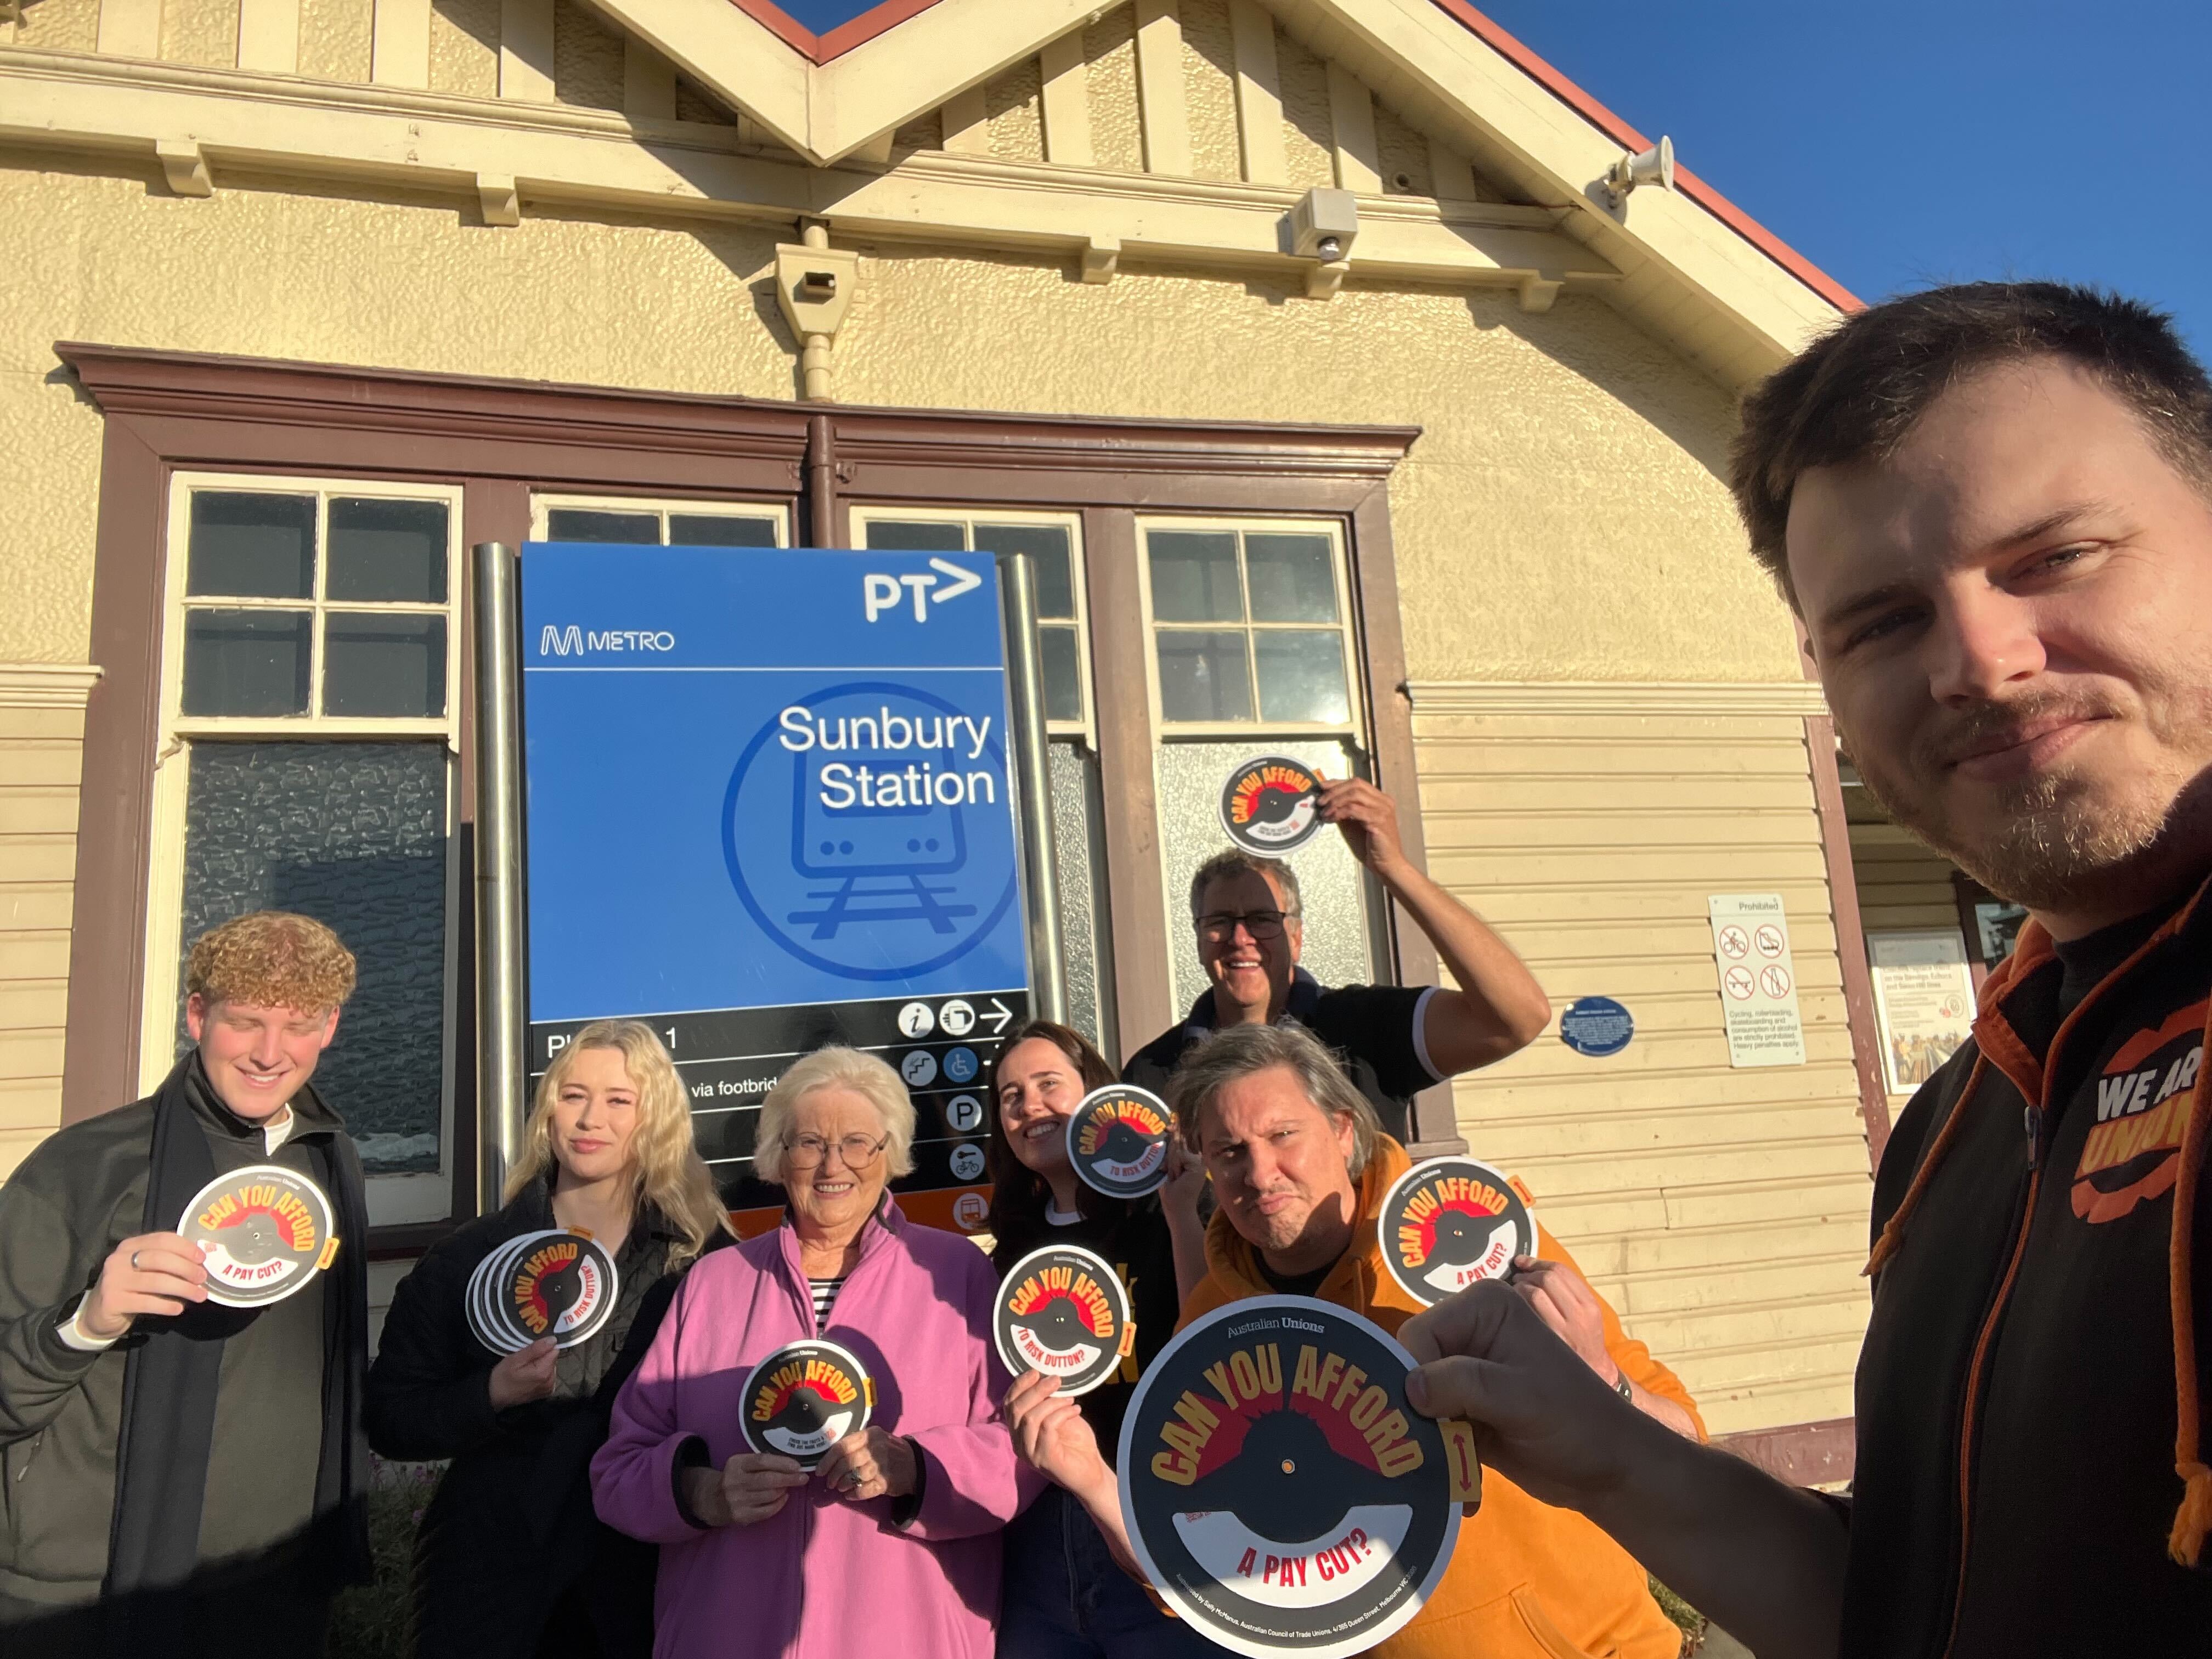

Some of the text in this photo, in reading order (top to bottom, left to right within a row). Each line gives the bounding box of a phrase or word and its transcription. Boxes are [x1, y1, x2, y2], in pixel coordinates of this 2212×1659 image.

[589, 631, 675, 651] METRO
[779, 706, 991, 760] Sunbury
[820, 763, 995, 809] Station
[1235, 771, 1263, 795] YOU
[1261, 766, 1312, 793] AFFORD
[1231, 795, 1249, 823] CAN
[1739, 901, 1778, 911] Prohibited
[665, 1027, 676, 1049] 1
[691, 1076, 777, 1098] via footbrid
[2097, 1046, 2203, 1121] WE AR
[1079, 1100, 1166, 1155] CAN YOU AFFORD
[198, 1185, 315, 1252] CAN YOU AFFORD
[1398, 1177, 1509, 1268] CAN YOU AFFORD
[222, 1260, 283, 1280] A PAY CUT?
[523, 1243, 578, 1277] AFFORD
[1457, 1272, 1464, 1285] A
[1466, 1264, 1488, 1286] PAY
[1485, 1242, 1508, 1270] CUT?
[514, 1275, 535, 1305] YOU
[1008, 1266, 1114, 1338] CAN YOU AFFORD
[518, 1304, 549, 1334] CAN
[1227, 1316, 1325, 1339] Australian Unions
[1018, 1328, 1030, 1341] TO
[1024, 1338, 1044, 1362] RISK
[1044, 1349, 1085, 1368] DUTTON?
[751, 1359, 857, 1421] CAN YOU AFFORD
[1152, 1342, 1424, 1486] CAN YOU AFFORD
[1237, 1527, 1373, 1588] A PAY CUT?
[1198, 1595, 1205, 1604] by
[1203, 1600, 1216, 1613] Sally
[1240, 1621, 1267, 1635] Australian
[1267, 1628, 1288, 1638] Council
[1333, 1620, 1348, 1632] 4/365
[1347, 1615, 1365, 1629] Queen
[1379, 1585, 1402, 1609] Melbourne
